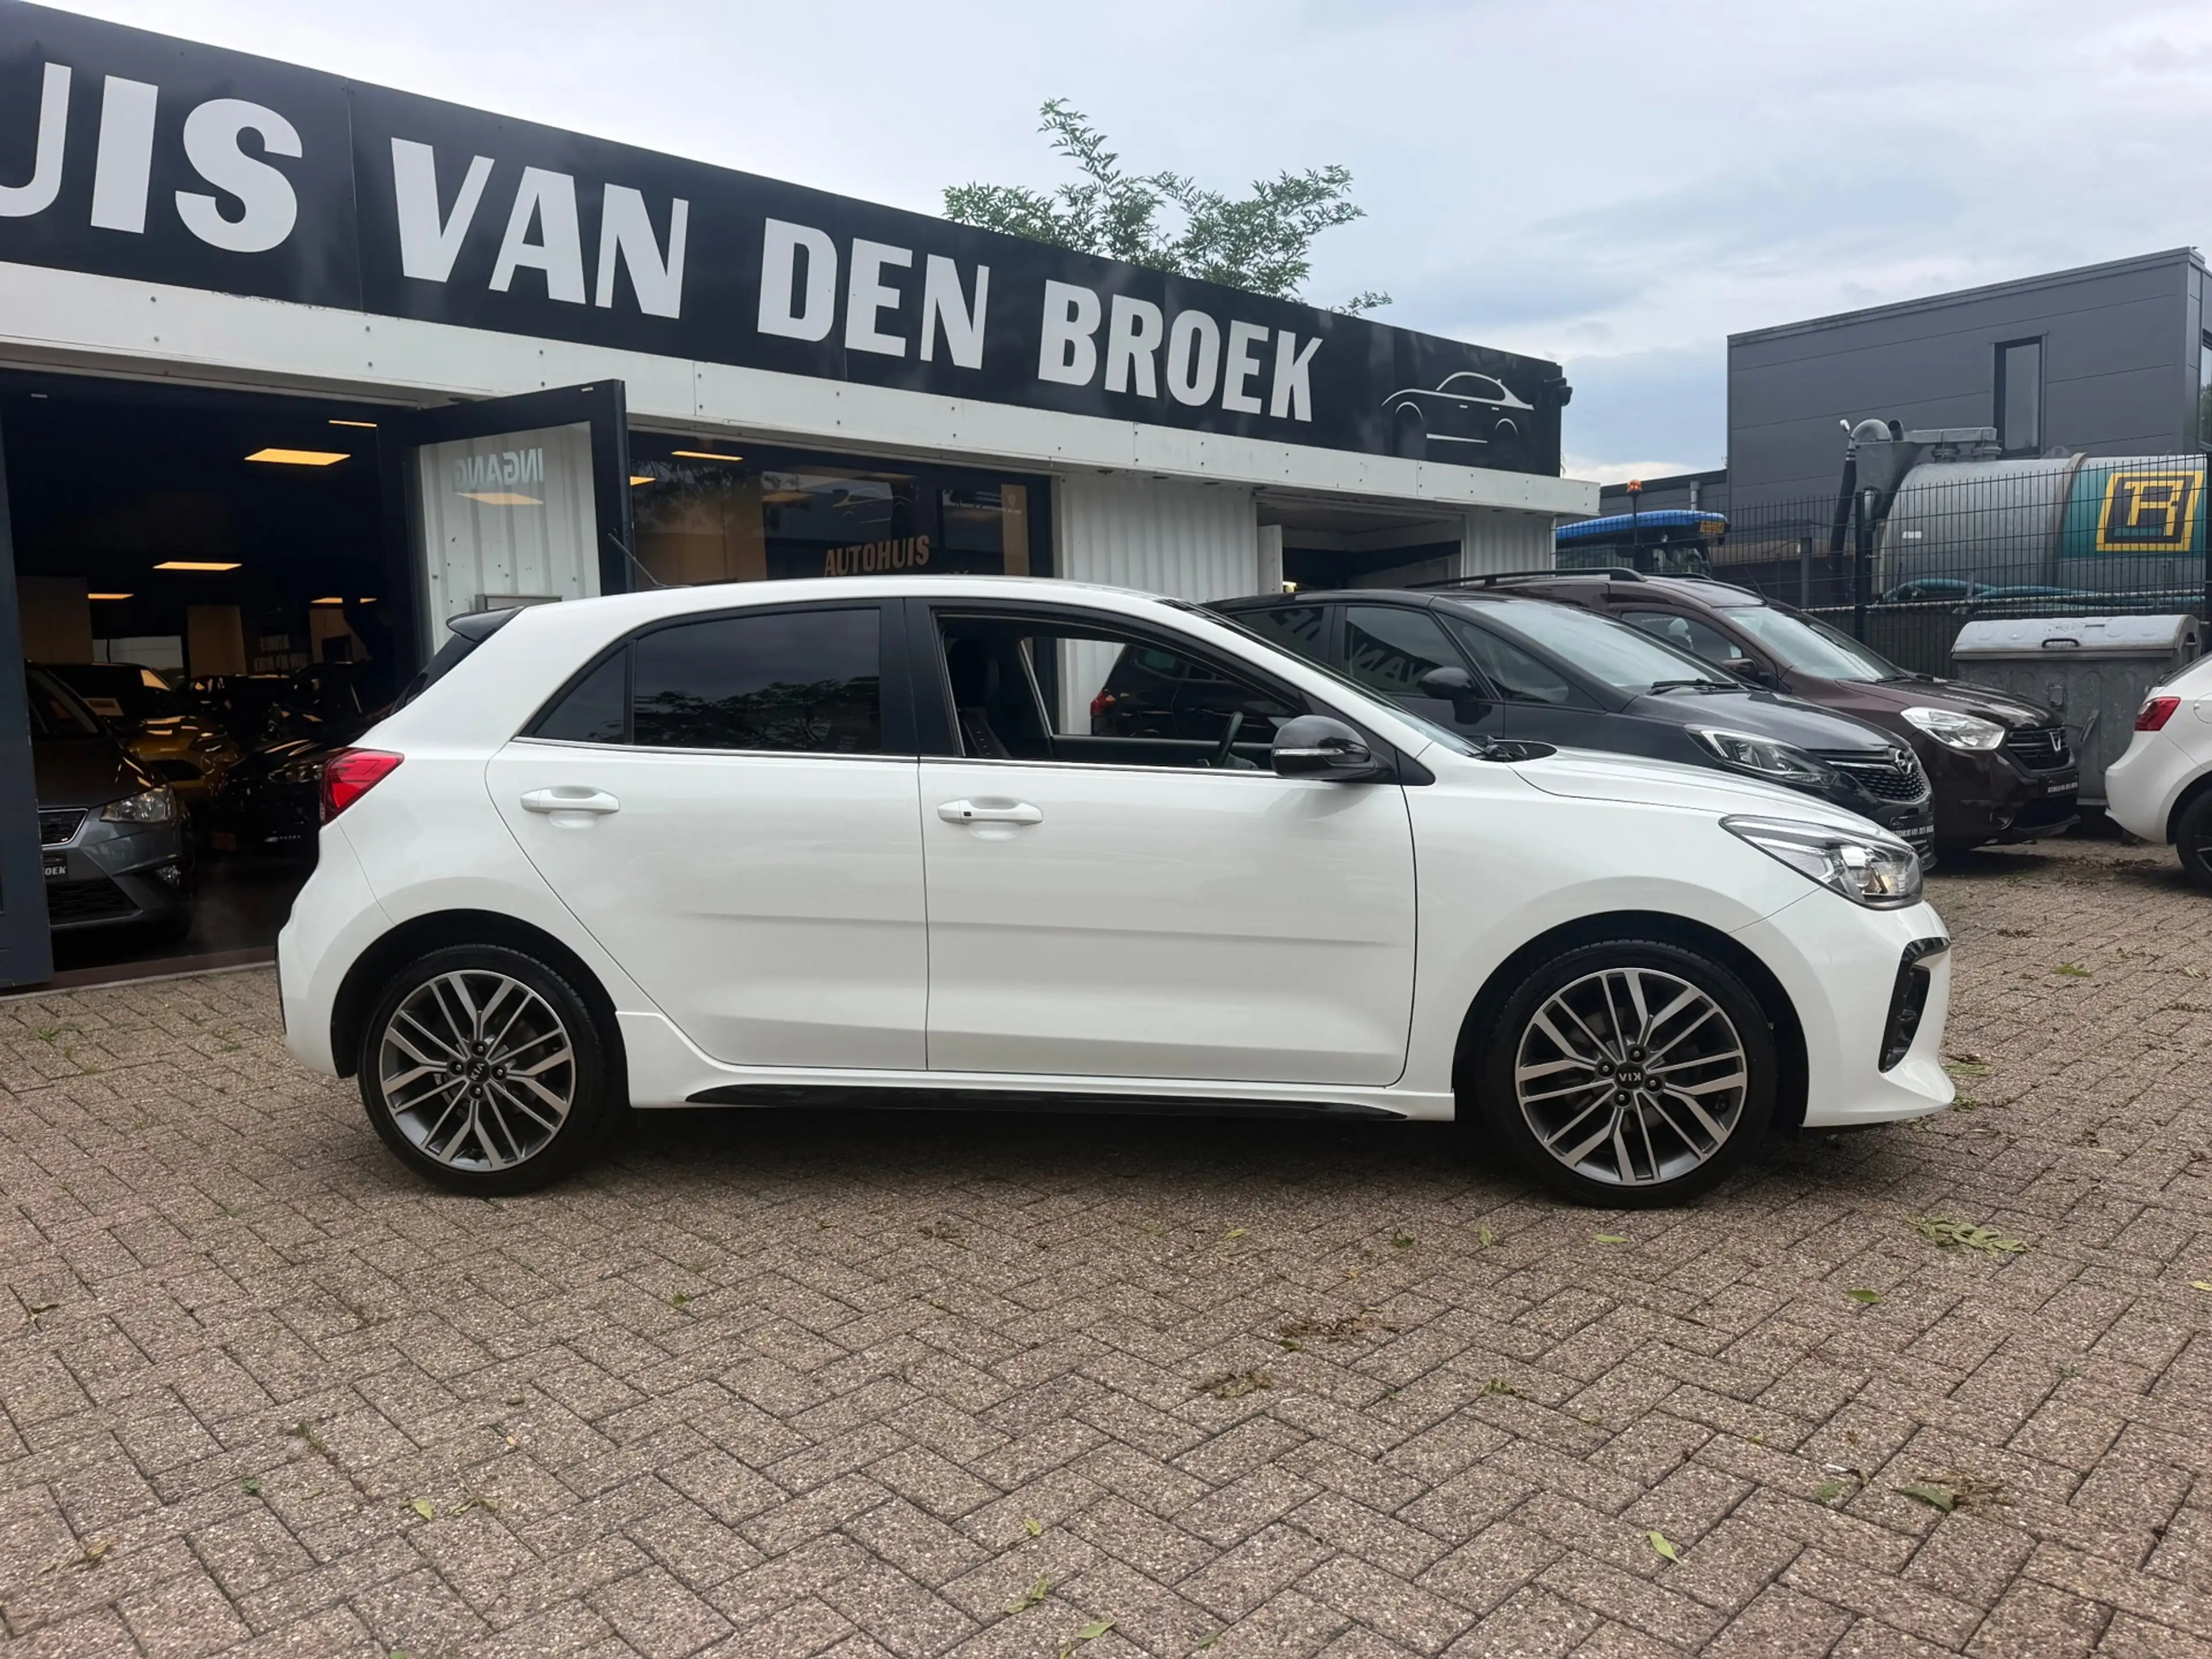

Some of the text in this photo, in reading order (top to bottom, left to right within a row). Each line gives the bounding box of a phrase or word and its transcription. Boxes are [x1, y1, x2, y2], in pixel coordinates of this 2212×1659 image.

[391, 137, 688, 319] VAN
[757, 218, 990, 369] DEN
[1038, 279, 1323, 422] BROEK
[824, 535, 929, 577] AUTOHUIS
